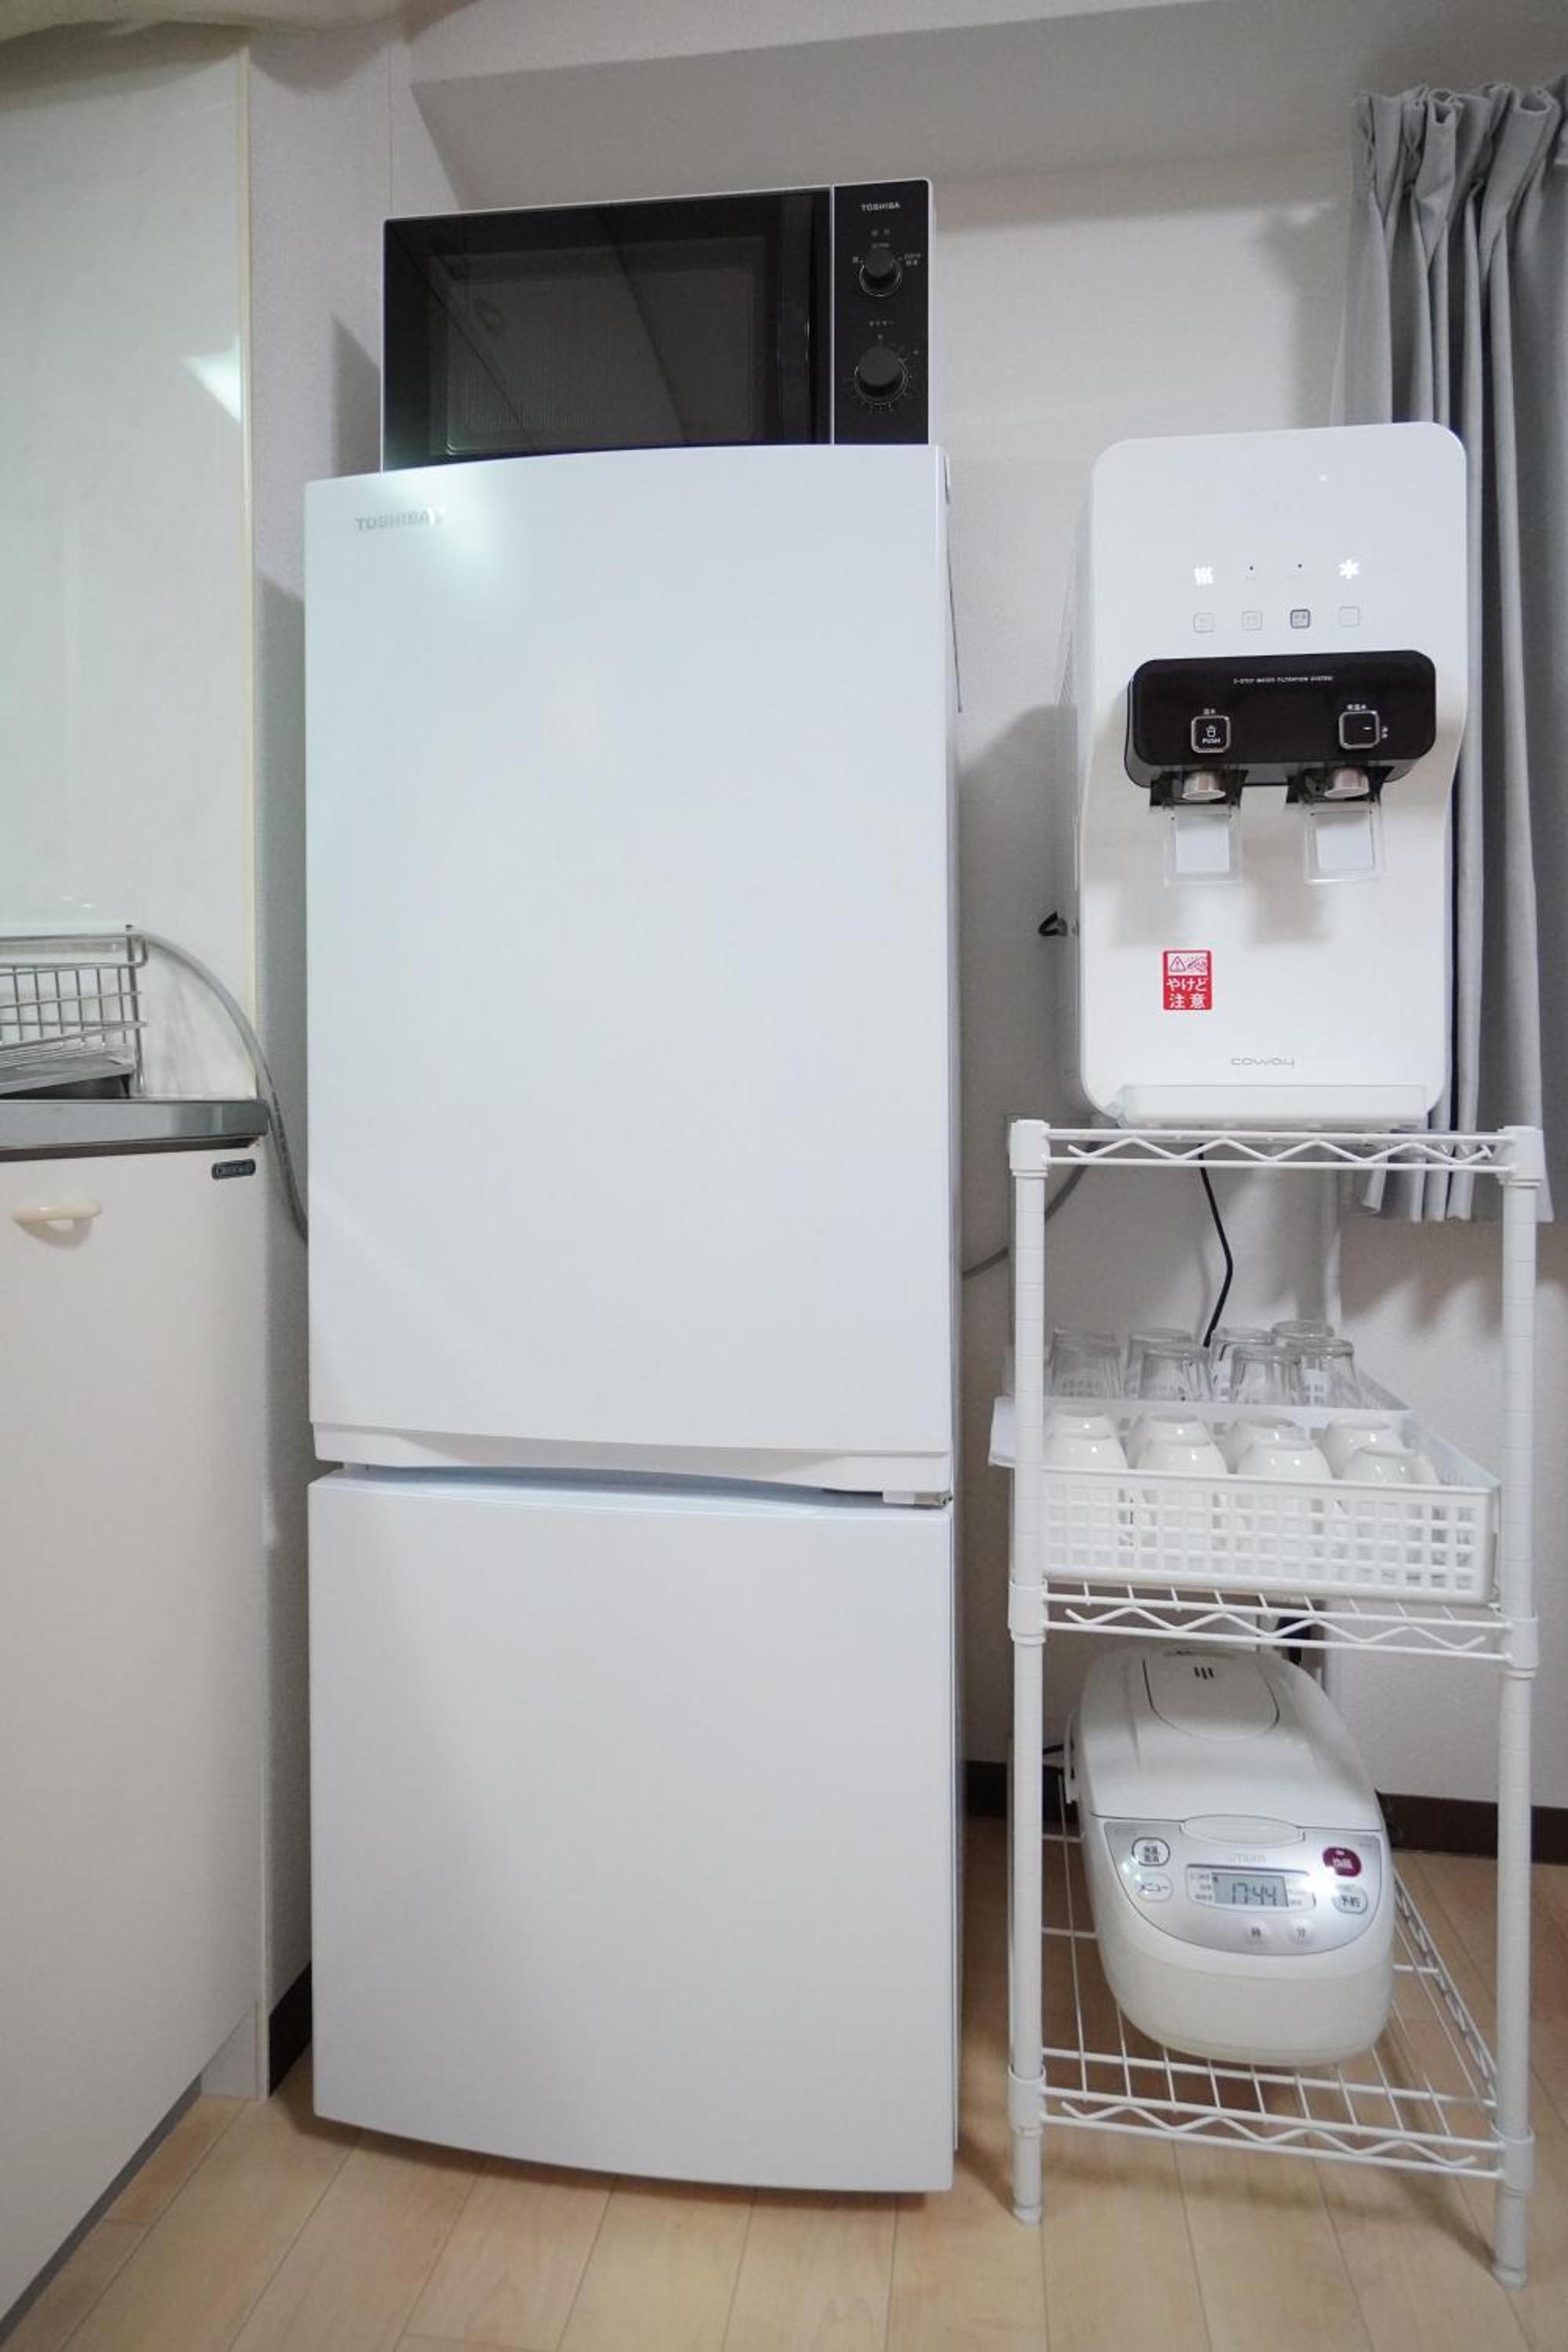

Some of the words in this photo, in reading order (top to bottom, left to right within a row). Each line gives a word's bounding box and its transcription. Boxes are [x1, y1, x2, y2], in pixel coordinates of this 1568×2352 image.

[862, 201, 900, 211] TOSHIBA
[354, 510, 434, 530] TOSHIBA
[1166, 977, 1209, 992] やけど
[1169, 993, 1205, 1009] 注意
[1230, 1057, 1295, 1069] coway
